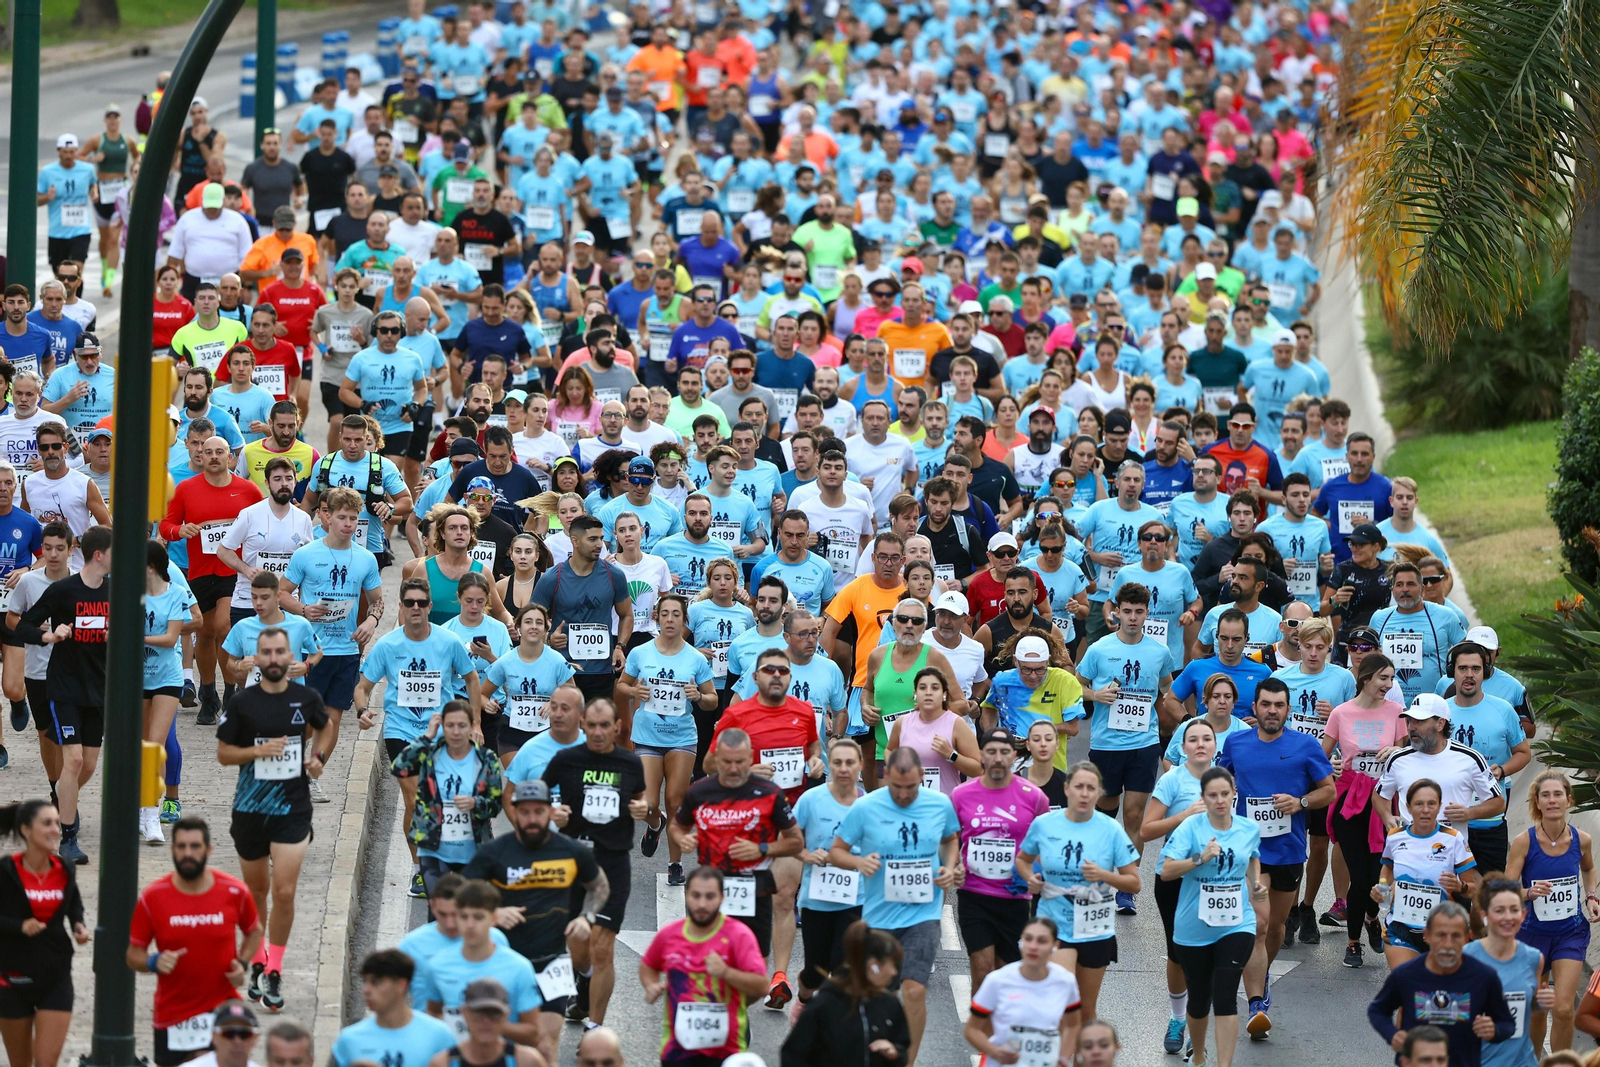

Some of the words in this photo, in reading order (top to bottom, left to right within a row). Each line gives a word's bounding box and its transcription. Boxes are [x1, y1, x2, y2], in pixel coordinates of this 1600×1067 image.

[201, 350, 222, 360] 3246
[258, 375, 280, 384] 6003
[576, 634, 603, 644] 7000
[1390, 644, 1416, 654] 1540
[406, 682, 435, 692] 3095
[654, 688, 680, 701] 3214
[517, 706, 543, 716] 321
[1117, 704, 1144, 716] 3085
[1294, 713, 1304, 722] 43
[1352, 720, 1385, 735] JUST
[1360, 761, 1385, 772] 9777
[583, 770, 614, 784] RUN
[586, 795, 616, 807] 3171
[1254, 809, 1284, 821] 6600
[972, 851, 1012, 862] 11985
[821, 872, 851, 886] 1709
[890, 873, 930, 885] 11986
[1398, 881, 1408, 890] 43
[1206, 897, 1235, 909] 9630
[1401, 894, 1430, 909] 1096
[1544, 890, 1572, 904] 1405
[170, 911, 224, 928] mayoral
[1083, 907, 1110, 922] 1356
[687, 1018, 720, 1030] 1064
